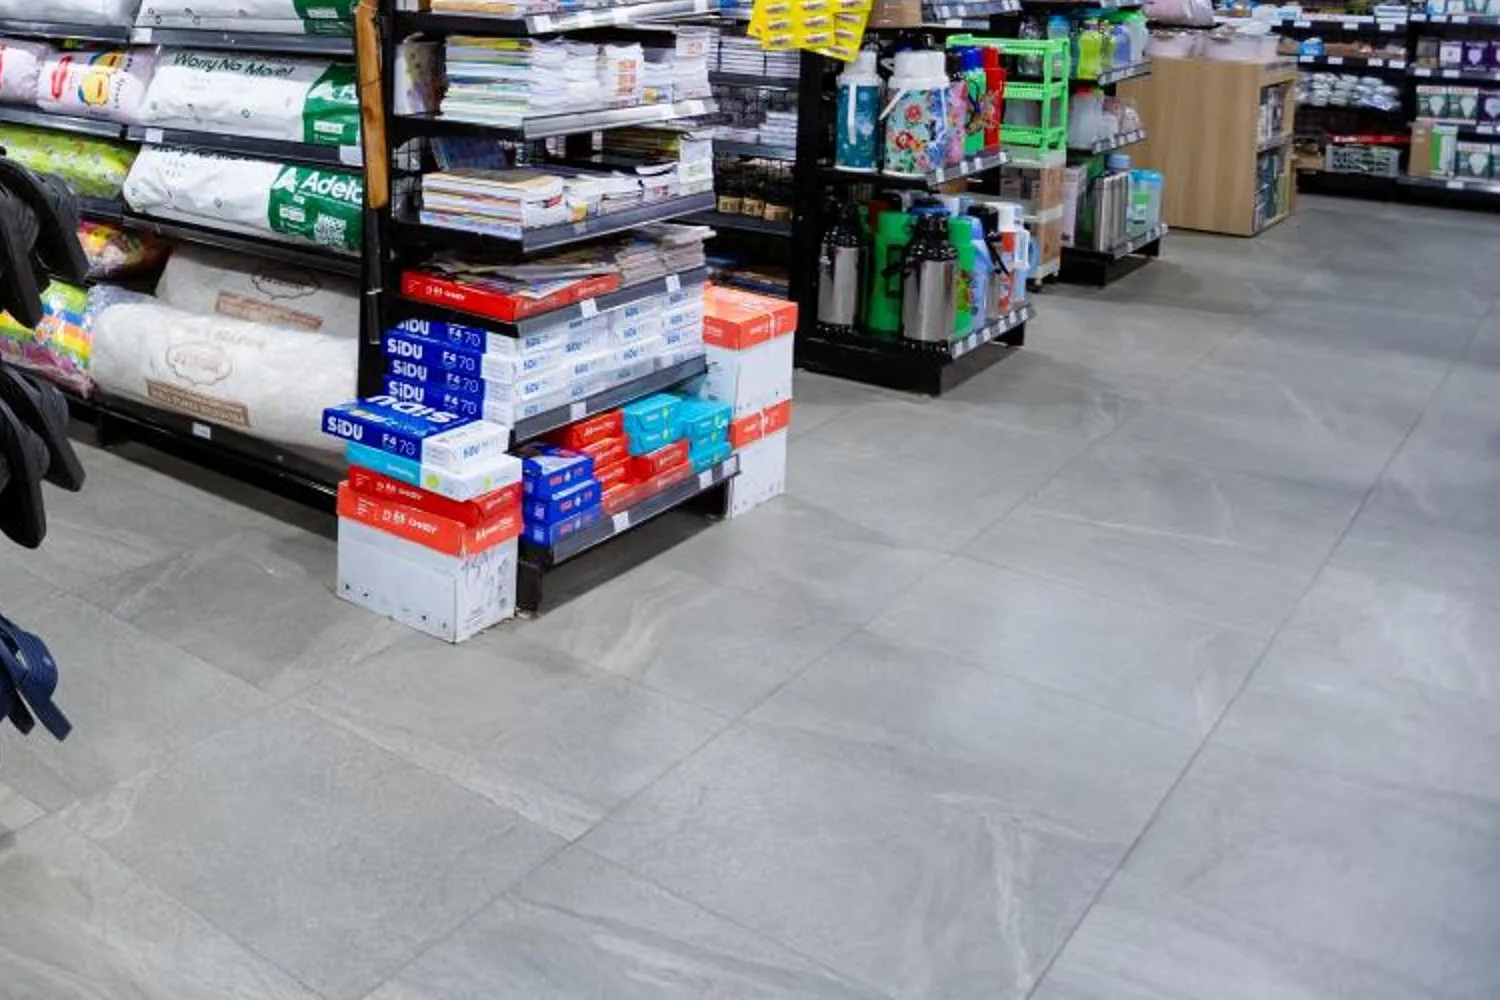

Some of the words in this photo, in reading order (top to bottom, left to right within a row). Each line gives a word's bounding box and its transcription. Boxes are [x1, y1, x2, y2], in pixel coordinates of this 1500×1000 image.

[174, 53, 218, 73] Worry
[218, 57, 243, 72] No
[245, 63, 296, 77] More!
